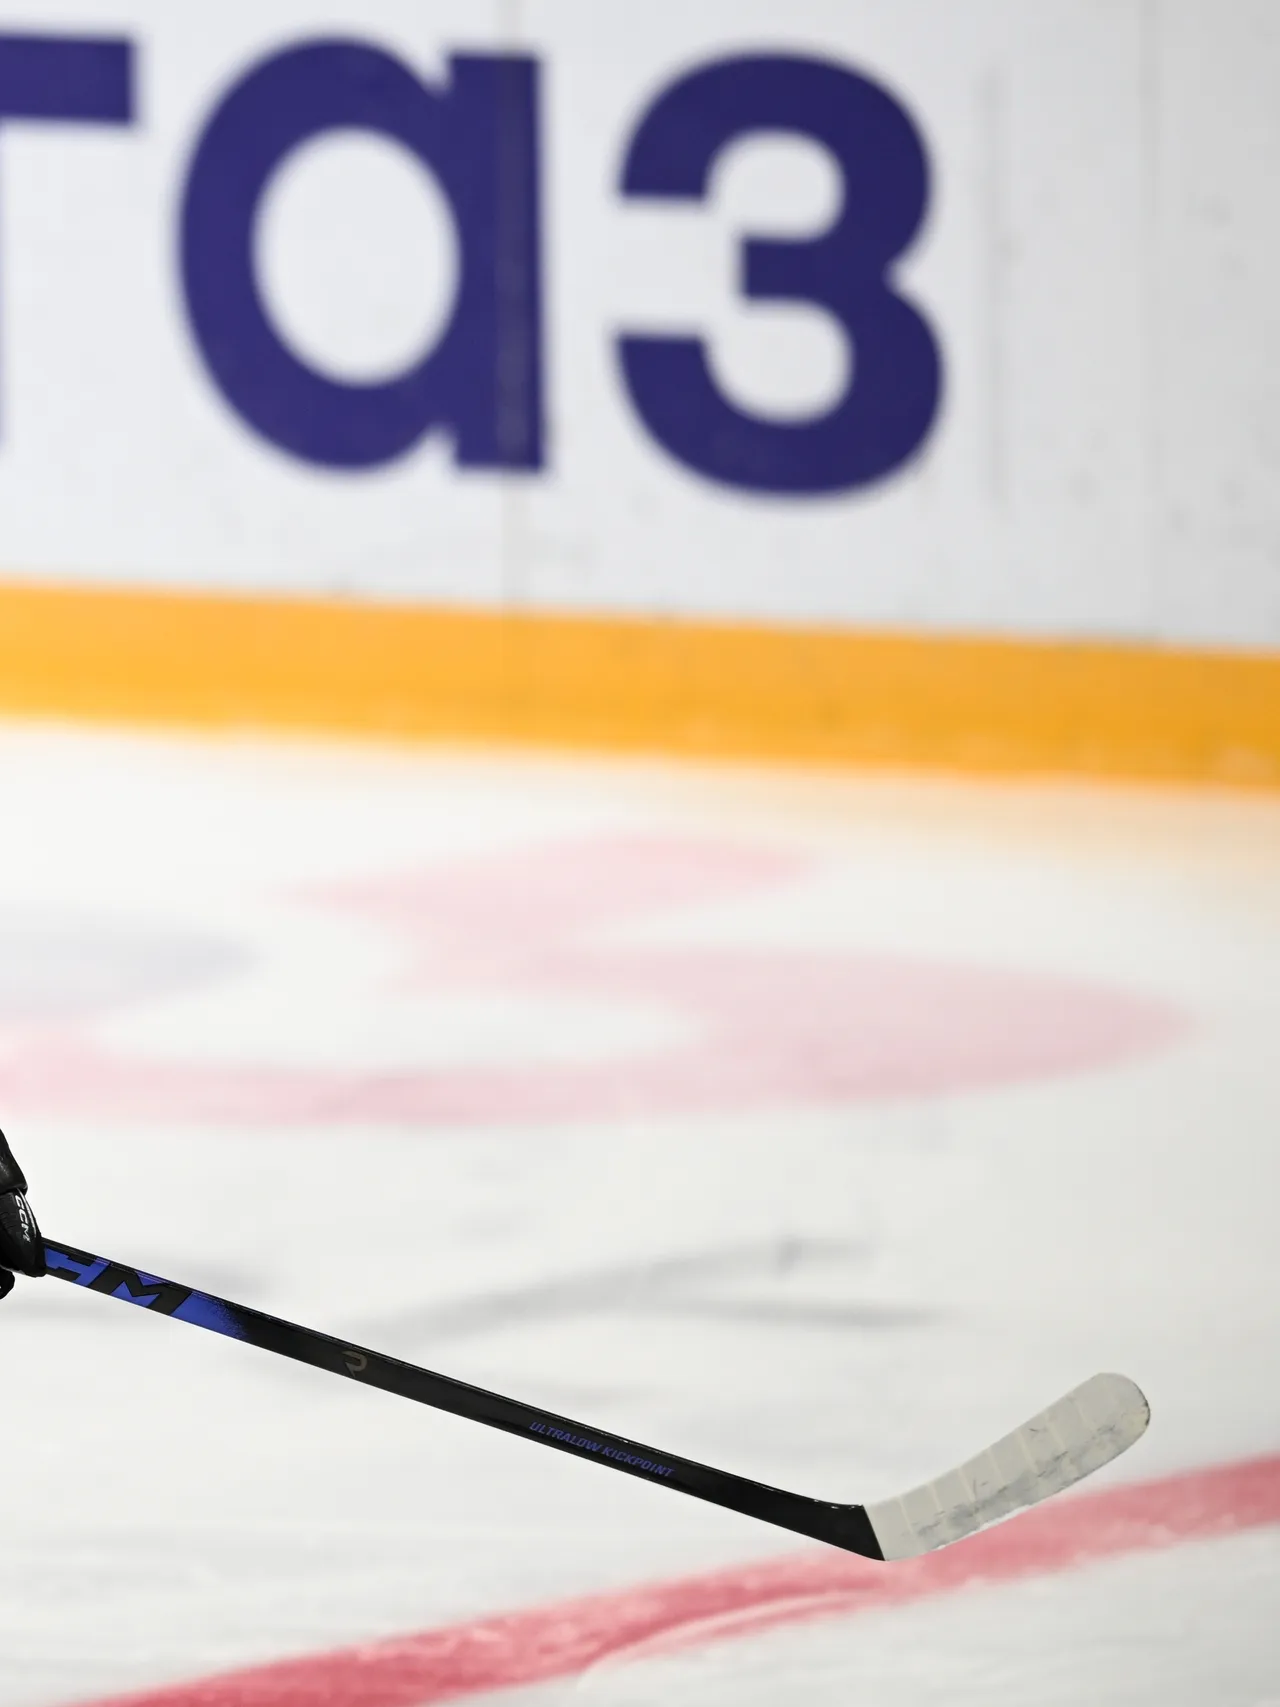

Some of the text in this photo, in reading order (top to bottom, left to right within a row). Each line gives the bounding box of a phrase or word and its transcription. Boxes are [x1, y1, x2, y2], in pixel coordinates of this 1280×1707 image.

[15, 1194, 31, 1244] CCM
[528, 1421, 676, 1478] ULTRALOW KICKPOINT
